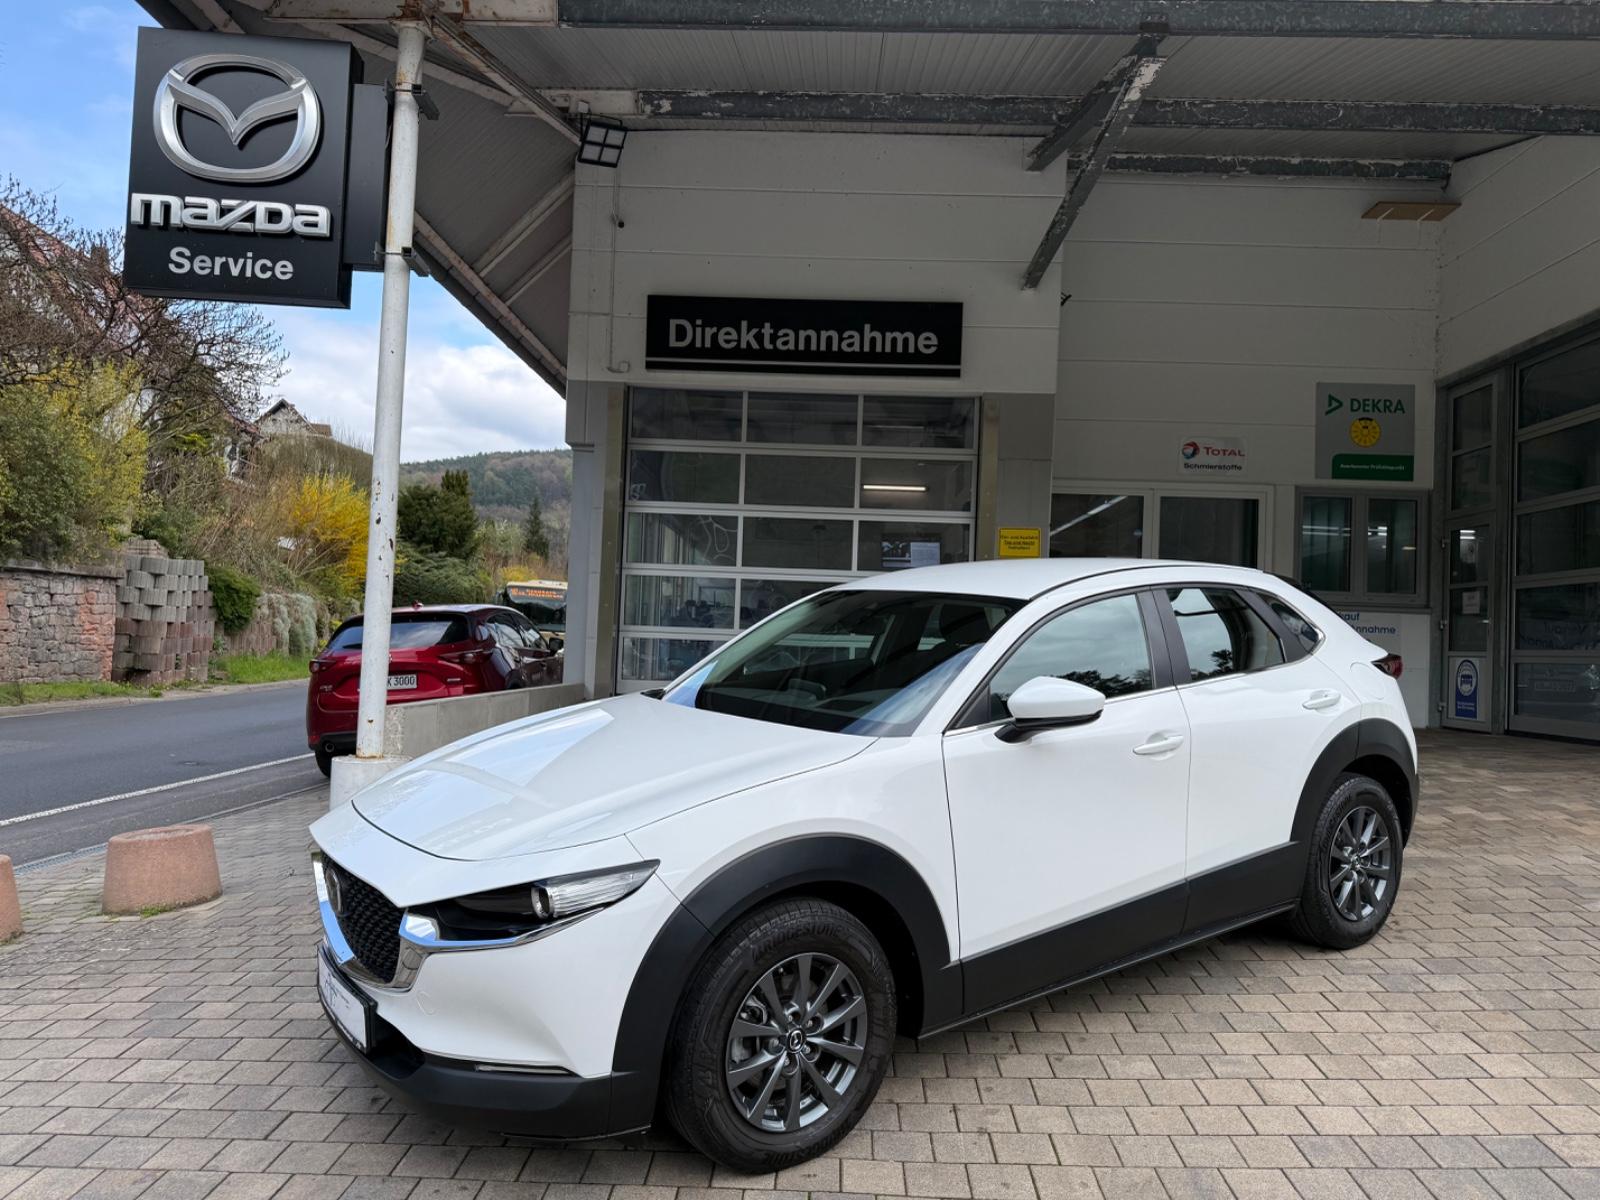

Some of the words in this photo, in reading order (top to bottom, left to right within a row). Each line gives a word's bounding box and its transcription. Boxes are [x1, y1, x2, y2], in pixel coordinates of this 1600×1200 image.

[168, 246, 294, 280] Service
[668, 318, 939, 354] Direktannahme
[1350, 398, 1405, 414] DEKRA
[393, 676, 416, 687] 3000
